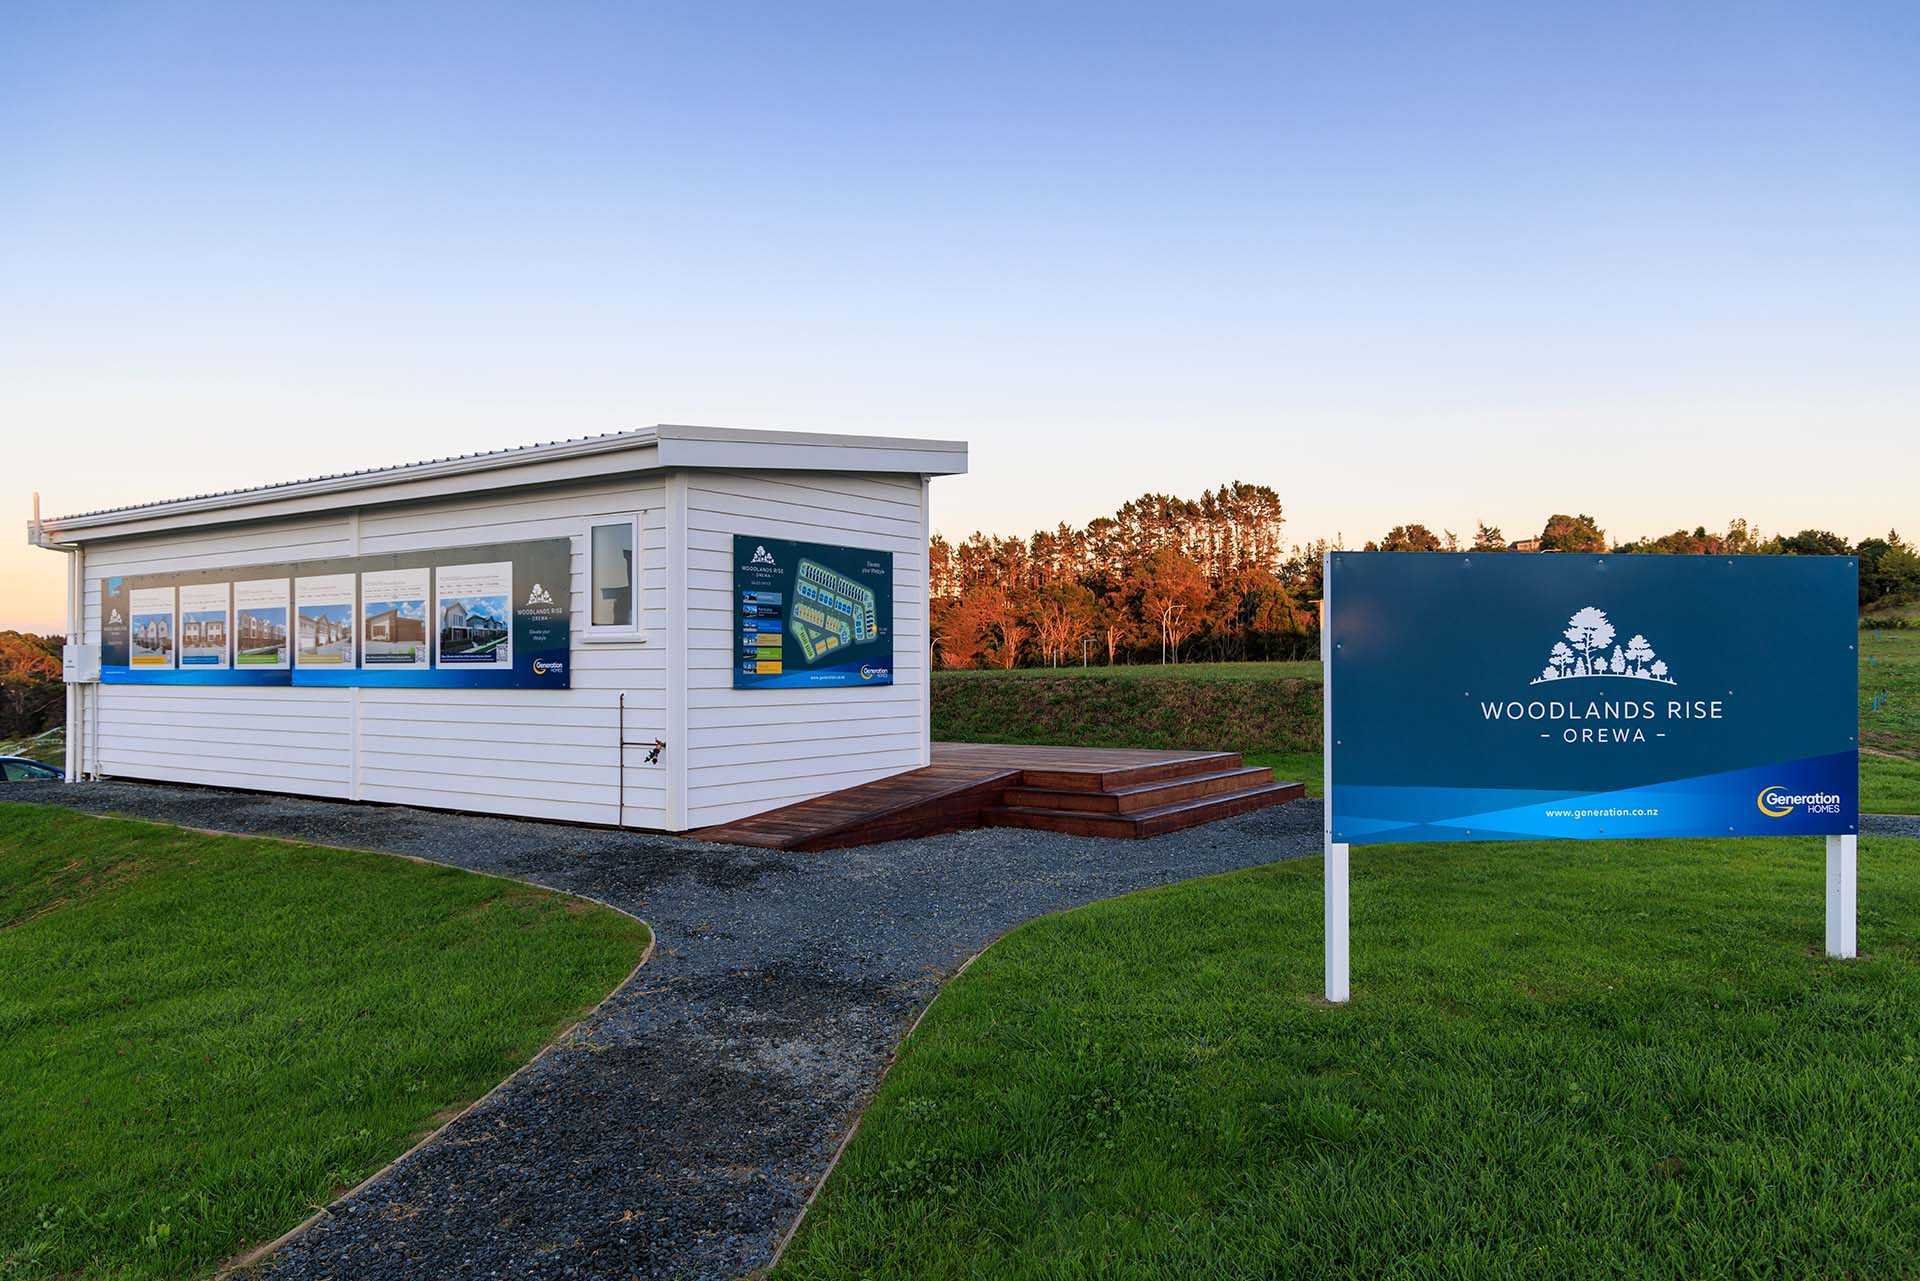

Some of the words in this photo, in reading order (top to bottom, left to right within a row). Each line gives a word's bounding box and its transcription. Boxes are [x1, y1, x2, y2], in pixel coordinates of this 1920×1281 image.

[517, 608, 550, 616] WOODLANDS
[536, 661, 562, 670] Generation
[863, 667, 889, 675] Generation
[1480, 700, 1656, 721] WOODLANDS
[1667, 700, 1724, 720] RISE
[1563, 728, 1646, 744] OREWA
[1765, 791, 1841, 806] Generation
[1545, 806, 1659, 820] www.generation.co.nz
[1807, 804, 1841, 814] HOMES
